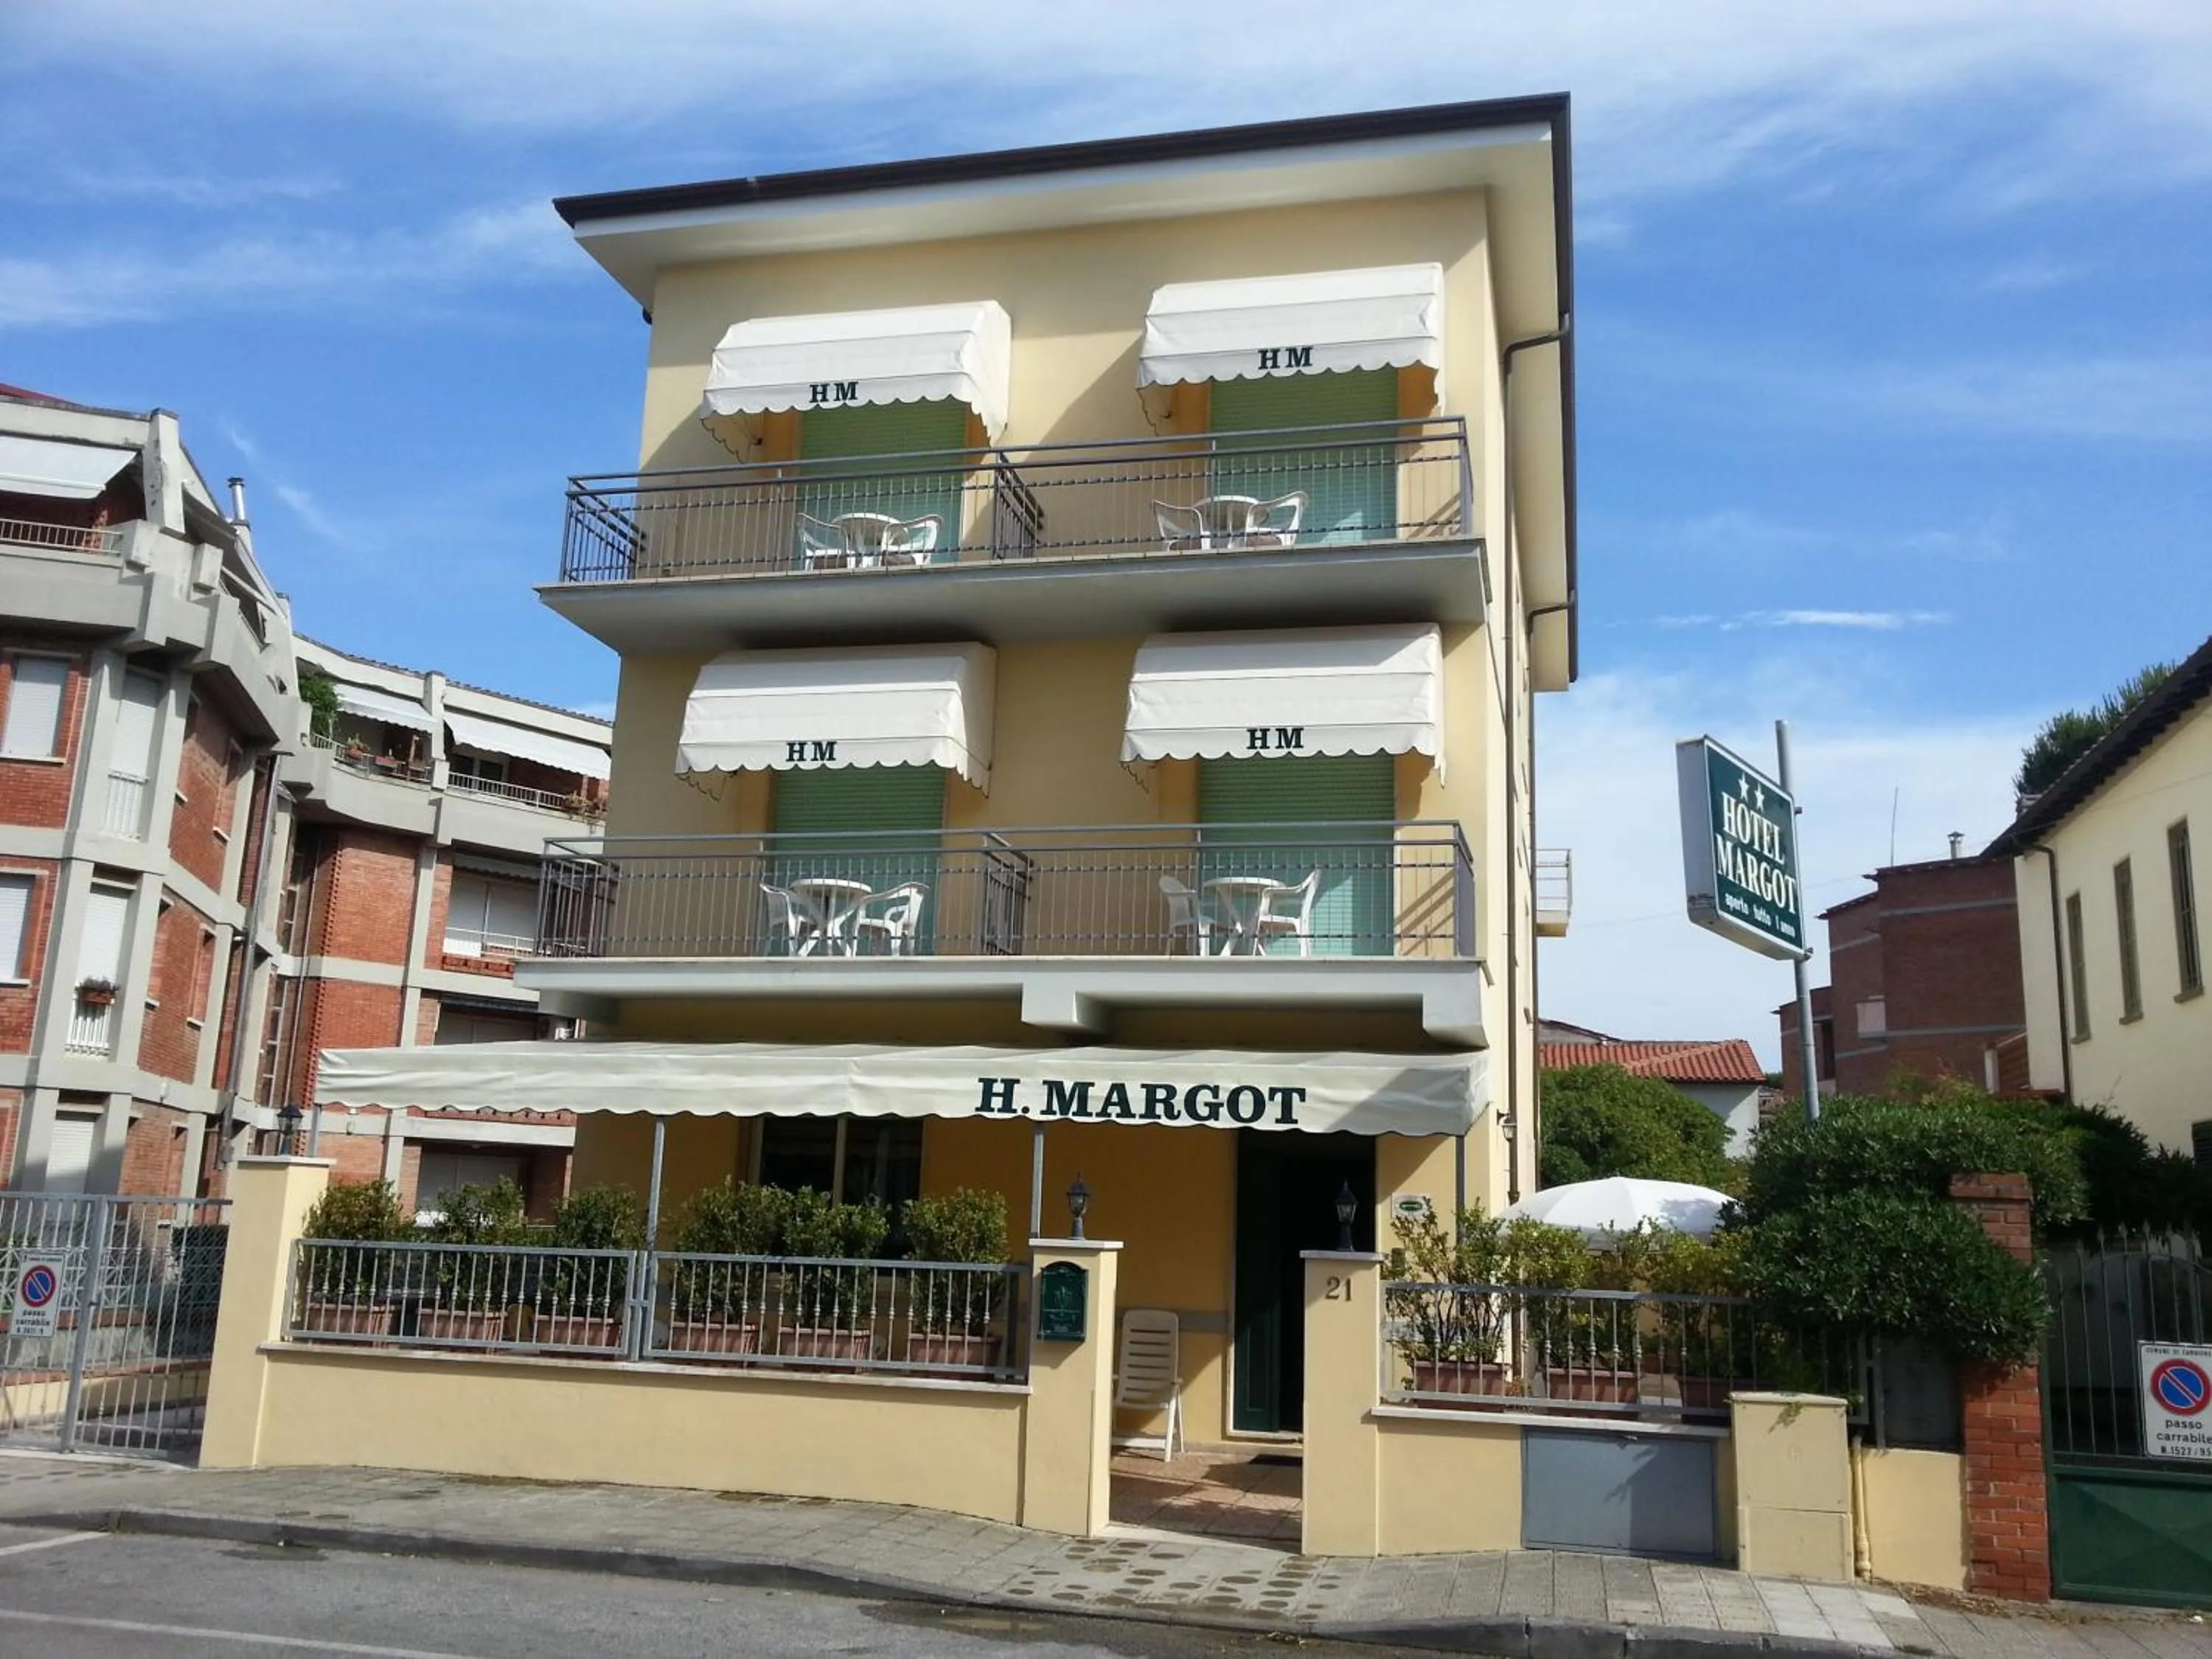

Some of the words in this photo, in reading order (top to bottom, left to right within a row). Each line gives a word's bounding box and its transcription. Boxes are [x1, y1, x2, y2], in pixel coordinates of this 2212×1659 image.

[1722, 791, 1785, 864] HOTEL
[1716, 833, 1796, 915] MARGOT
[1324, 1276, 1352, 1302] 21
[2165, 1419, 2203, 1430] passo
[2156, 1432, 2212, 1444] carrabile
